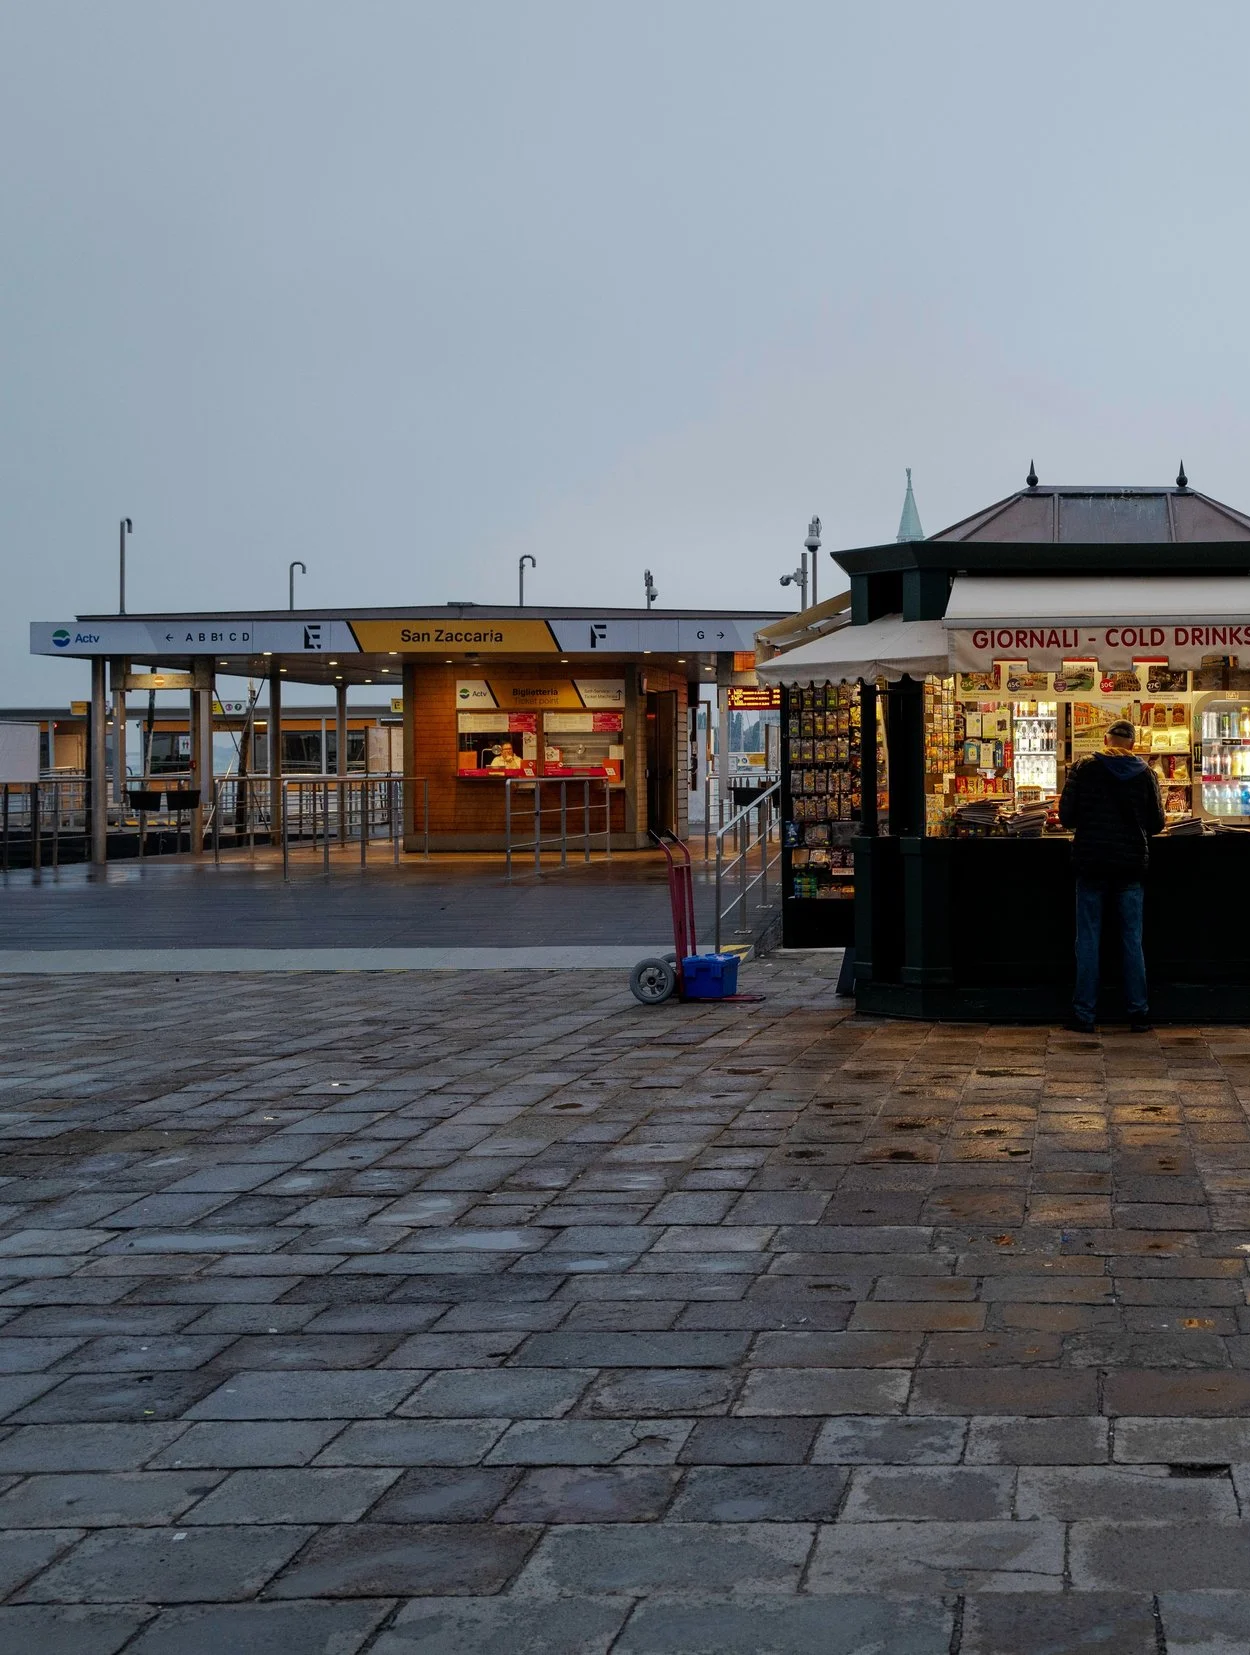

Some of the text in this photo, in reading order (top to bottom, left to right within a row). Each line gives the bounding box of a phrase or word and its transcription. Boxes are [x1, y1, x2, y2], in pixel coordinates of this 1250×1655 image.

[75, 633, 100, 643] Actv
[185, 632, 250, 642] A B B1 C D
[304, 625, 321, 649] E
[401, 629, 503, 642] San Zaccaria
[590, 624, 607, 648] F
[696, 630, 705, 640] G
[972, 629, 1078, 649] GIORNALI
[1105, 628, 1165, 647] COLD
